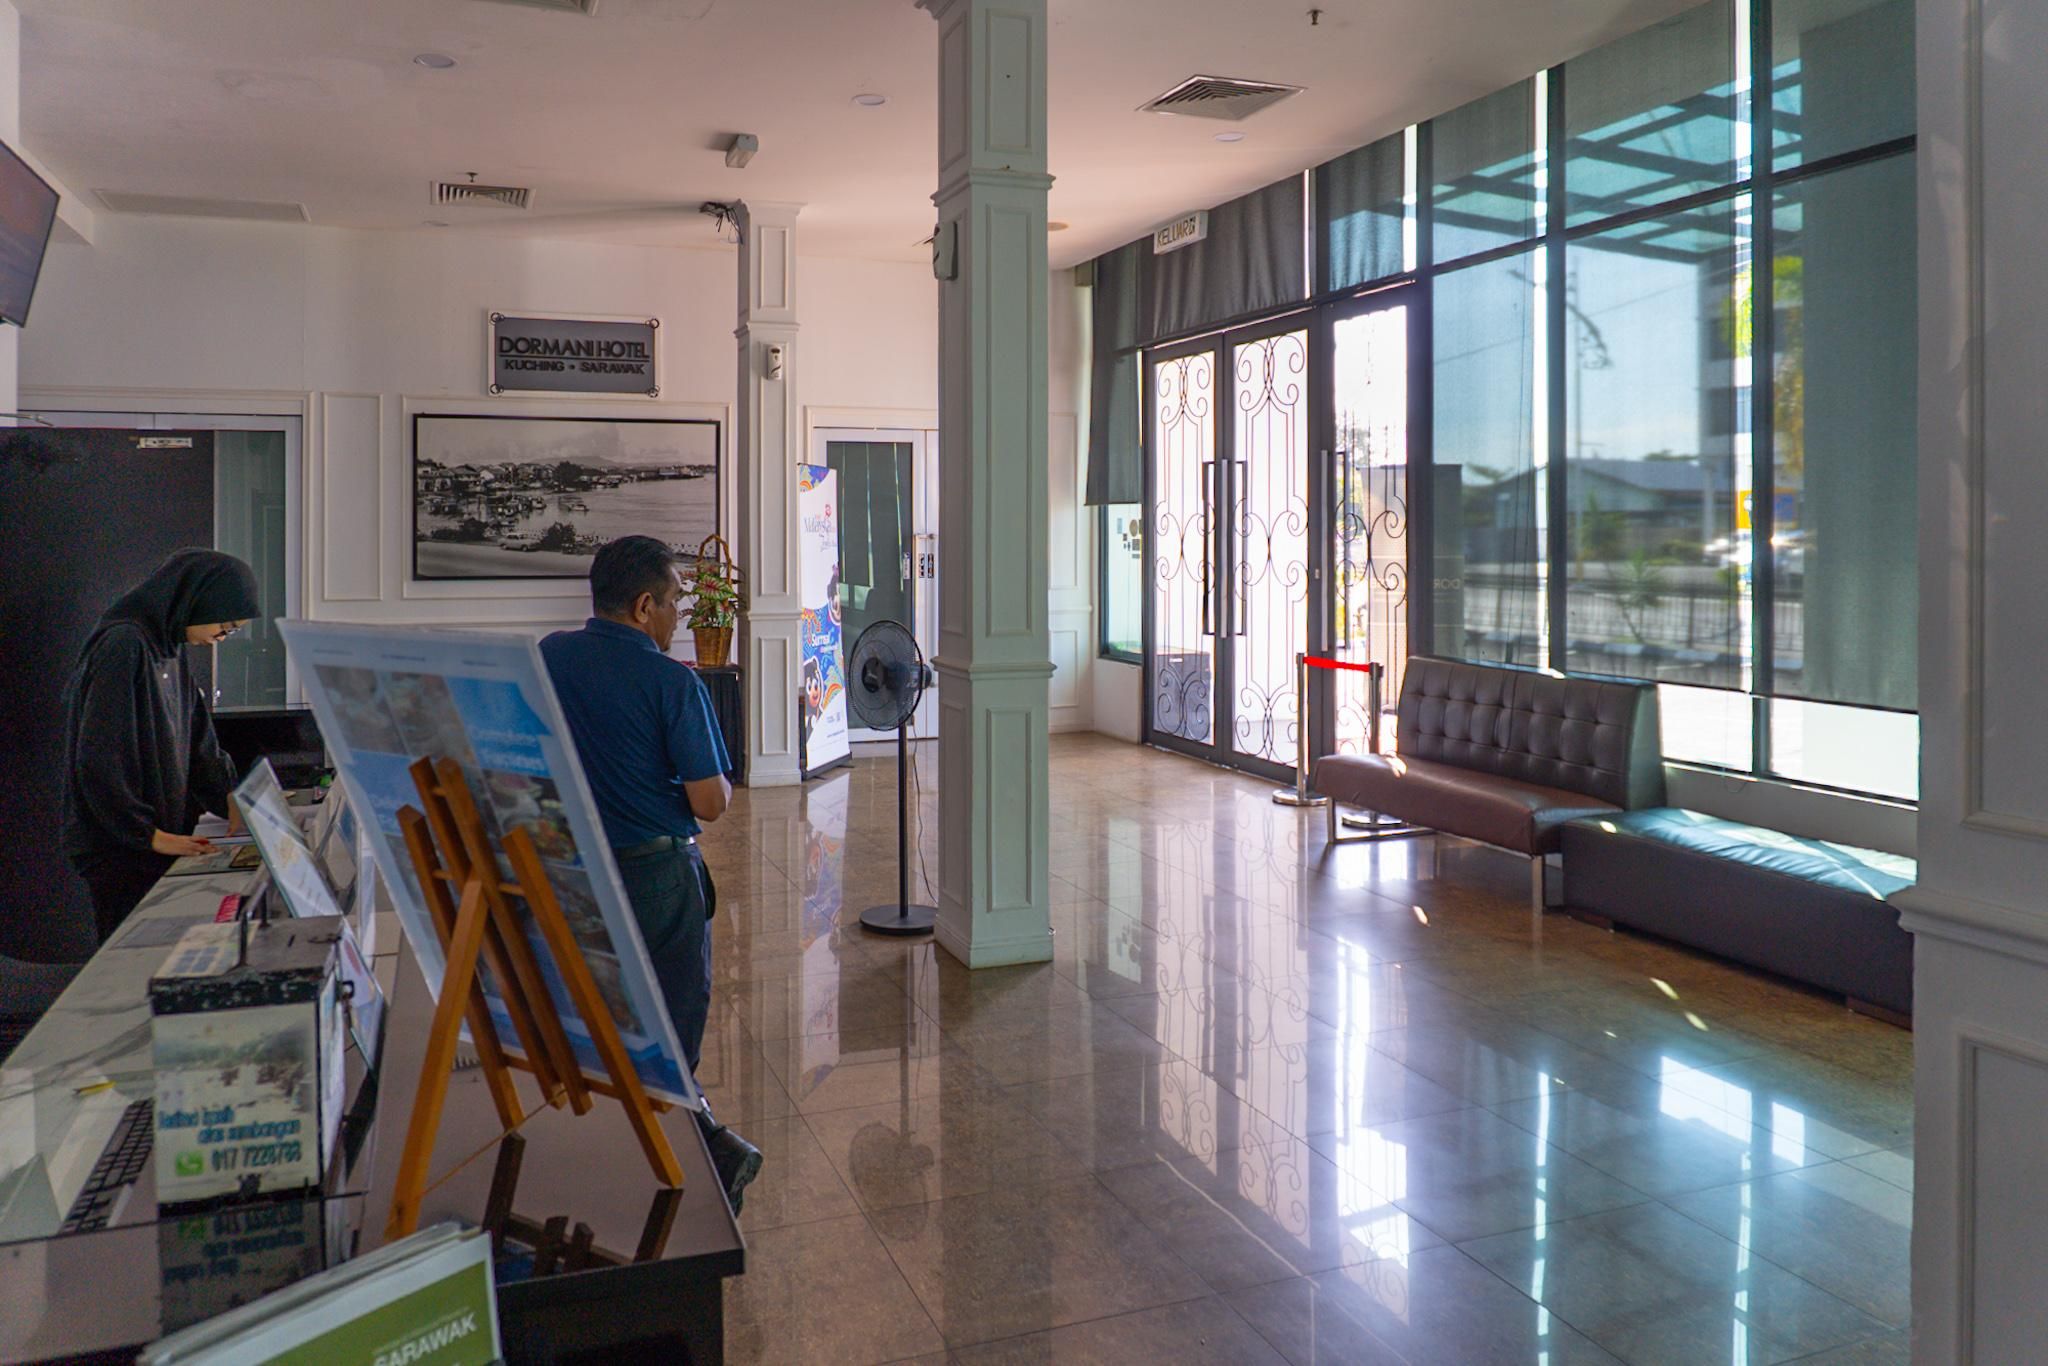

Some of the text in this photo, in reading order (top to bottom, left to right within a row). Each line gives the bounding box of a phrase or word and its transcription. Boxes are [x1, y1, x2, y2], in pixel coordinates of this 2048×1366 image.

[1157, 219, 1188, 248] KELUAR
[499, 336, 650, 358] DORMANI HOTEL
[504, 359, 645, 374] KUCHING SARAWAK
